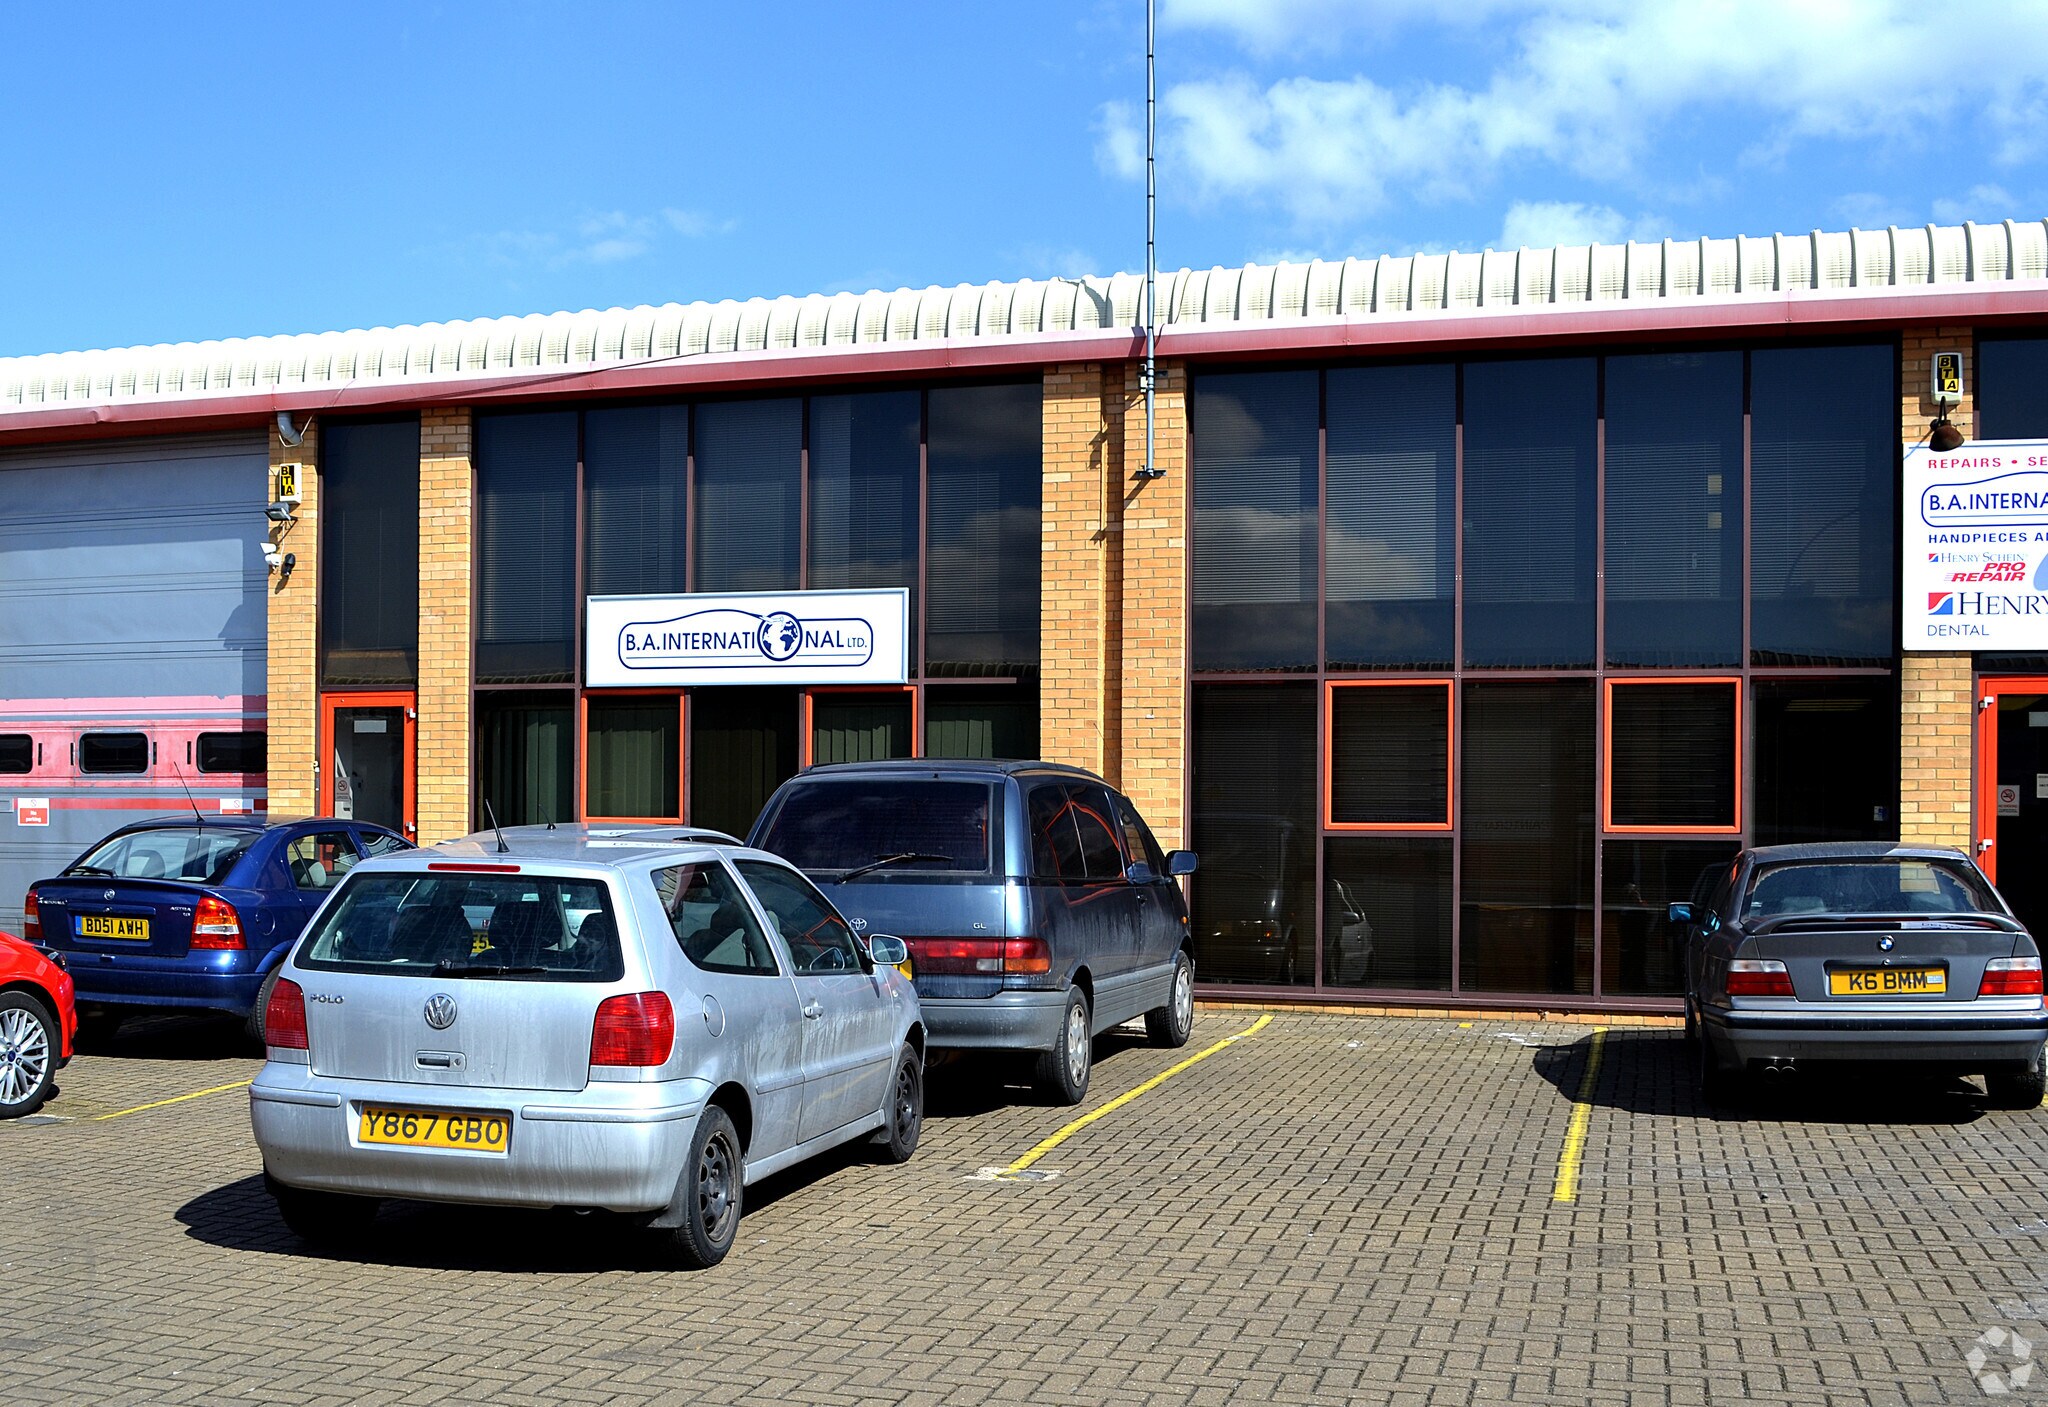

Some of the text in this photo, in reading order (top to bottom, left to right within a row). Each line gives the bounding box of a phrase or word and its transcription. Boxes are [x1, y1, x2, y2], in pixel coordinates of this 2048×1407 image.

[1928, 456, 2048, 468] REPAIRS SE
[1928, 532, 2048, 544] HANDPIECES A
[1983, 562, 2026, 572] PRO
[1951, 572, 2026, 582] REPAIR
[1927, 624, 1990, 637] DENTAL
[86, 918, 143, 936] BD51 AWH
[1849, 971, 1927, 991] K6 BMM
[310, 993, 345, 1004] POLO
[366, 1110, 503, 1145] Y867 GBO
